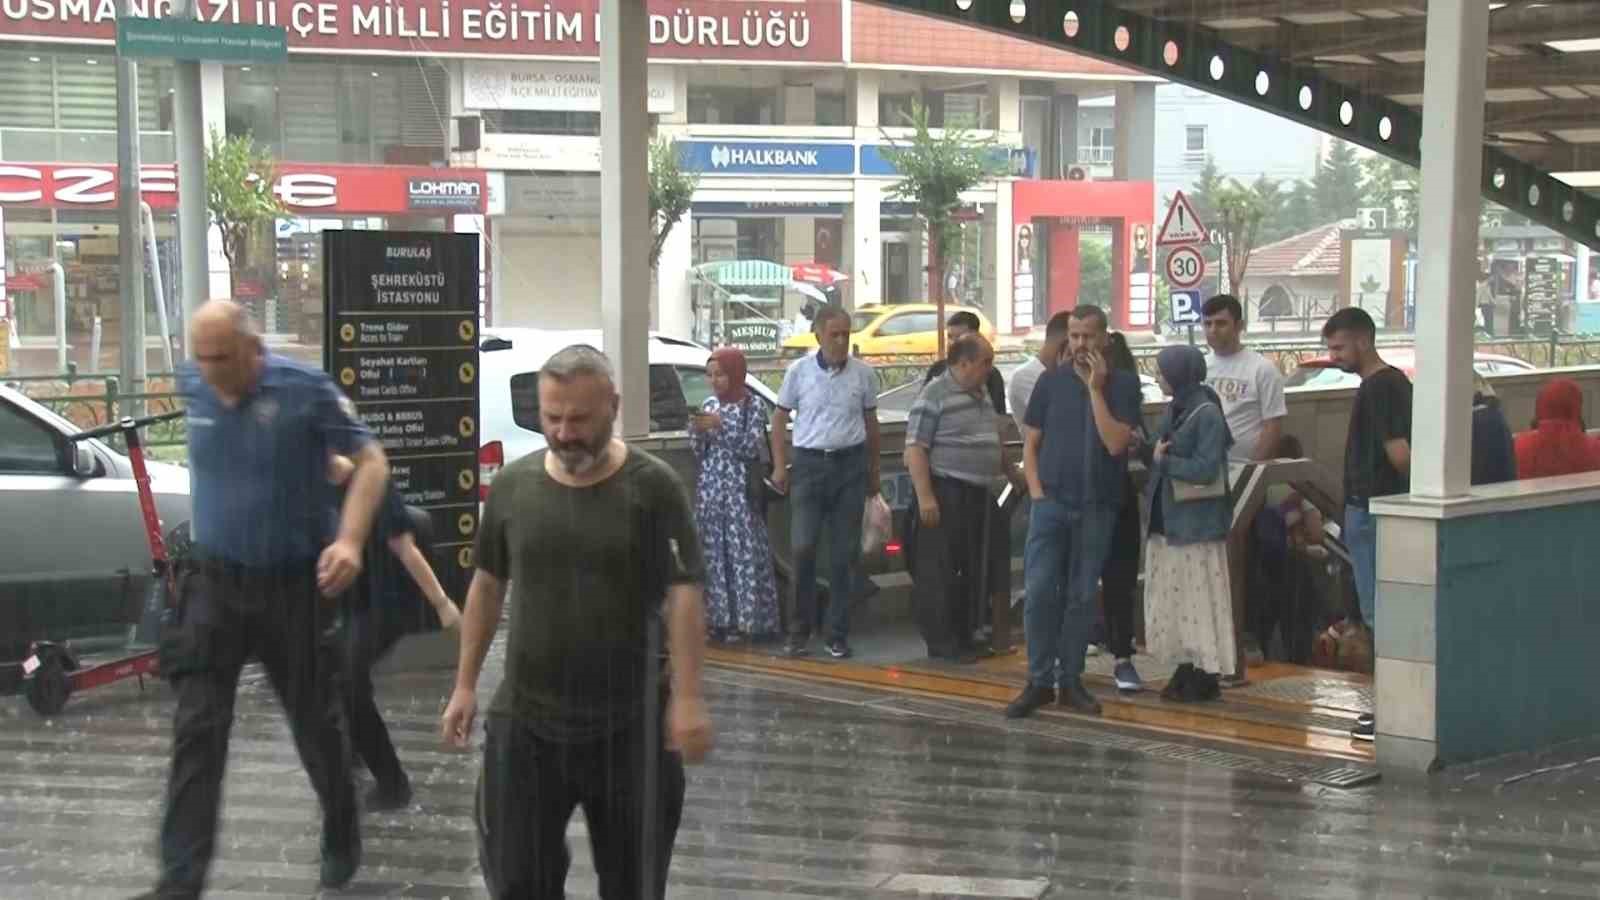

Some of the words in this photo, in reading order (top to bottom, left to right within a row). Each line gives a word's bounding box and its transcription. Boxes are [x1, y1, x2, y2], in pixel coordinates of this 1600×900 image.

[352, 0, 450, 37] MİLLİ
[462, 2, 583, 42] EĞİTİM
[731, 148, 818, 166] HALKBANK
[386, 246, 432, 261] BURULAŞ
[1173, 257, 1198, 277] 30
[371, 271, 445, 289] ŞEHREKÜSTÜ
[377, 289, 440, 304] İSTASYONU
[1171, 293, 1192, 322] P
